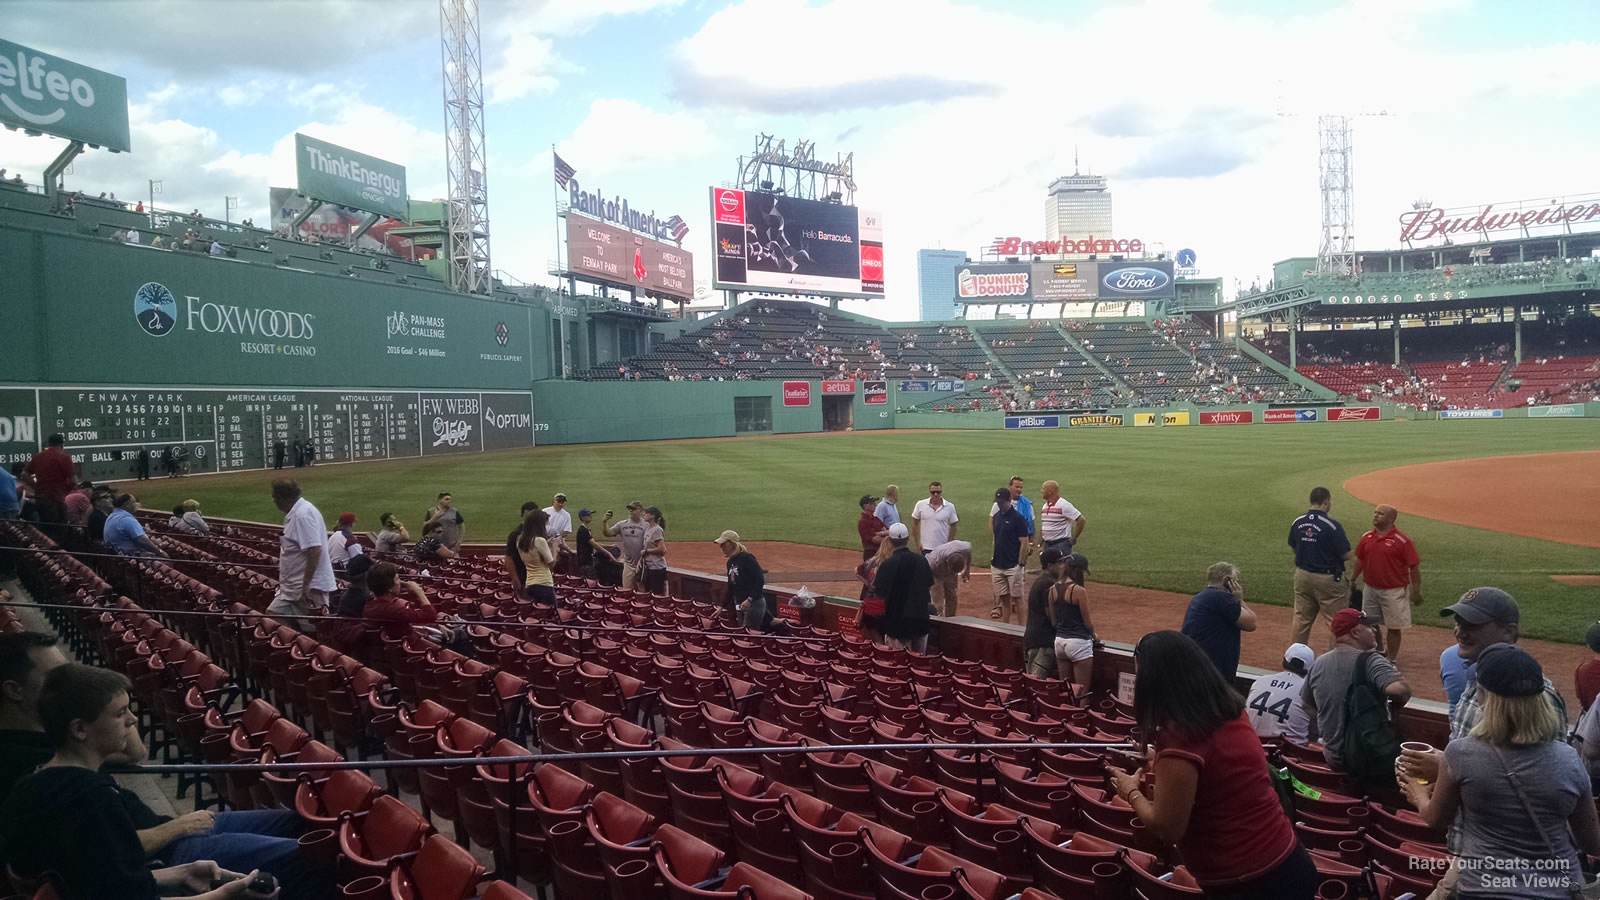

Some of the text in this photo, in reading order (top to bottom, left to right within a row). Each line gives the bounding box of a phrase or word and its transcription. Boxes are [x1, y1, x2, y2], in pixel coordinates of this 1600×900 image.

[306, 145, 401, 198] ThinkEnergy
[570, 178, 668, 239] Bank of America
[1400, 199, 1600, 242] Budweiser
[588, 228, 611, 244] WELCOME
[1022, 235, 1142, 255] new balance
[597, 246, 604, 256] TO
[583, 256, 618, 274] FENWAY PARK
[978, 274, 1028, 285] DUNKIN'
[1117, 270, 1156, 289] Ford
[979, 284, 1025, 295] DONUTS
[184, 295, 313, 339] FOXWOODS
[411, 314, 445, 328] PAN-MASS
[411, 327, 445, 339] CHALLENGE
[241, 342, 316, 356] RESORT CASINO
[387, 346, 400, 354] 2016
[401, 346, 413, 355] Goal
[428, 348, 446, 357] Million
[827, 382, 850, 392] aetna
[79, 394, 183, 402] FENWAY PARK
[226, 394, 296, 402] AMERICAN LEAGUE
[57, 406, 63, 415] P
[422, 398, 479, 415] F.W. WEBB
[74, 418, 92, 427] CWS
[496, 414, 530, 428] OPTUM
[1070, 415, 1121, 426] GRANITE CITY
[1211, 412, 1240, 424] xfinity
[534, 423, 549, 431] 379
[68, 431, 98, 440] BOSTON
[9, 453, 32, 463] 1898
[71, 454, 85, 463] BAT
[92, 452, 113, 461] BALL
[779, 607, 800, 616] CAUTION
[1270, 679, 1293, 690] BAY
[1249, 691, 1293, 724] 44
